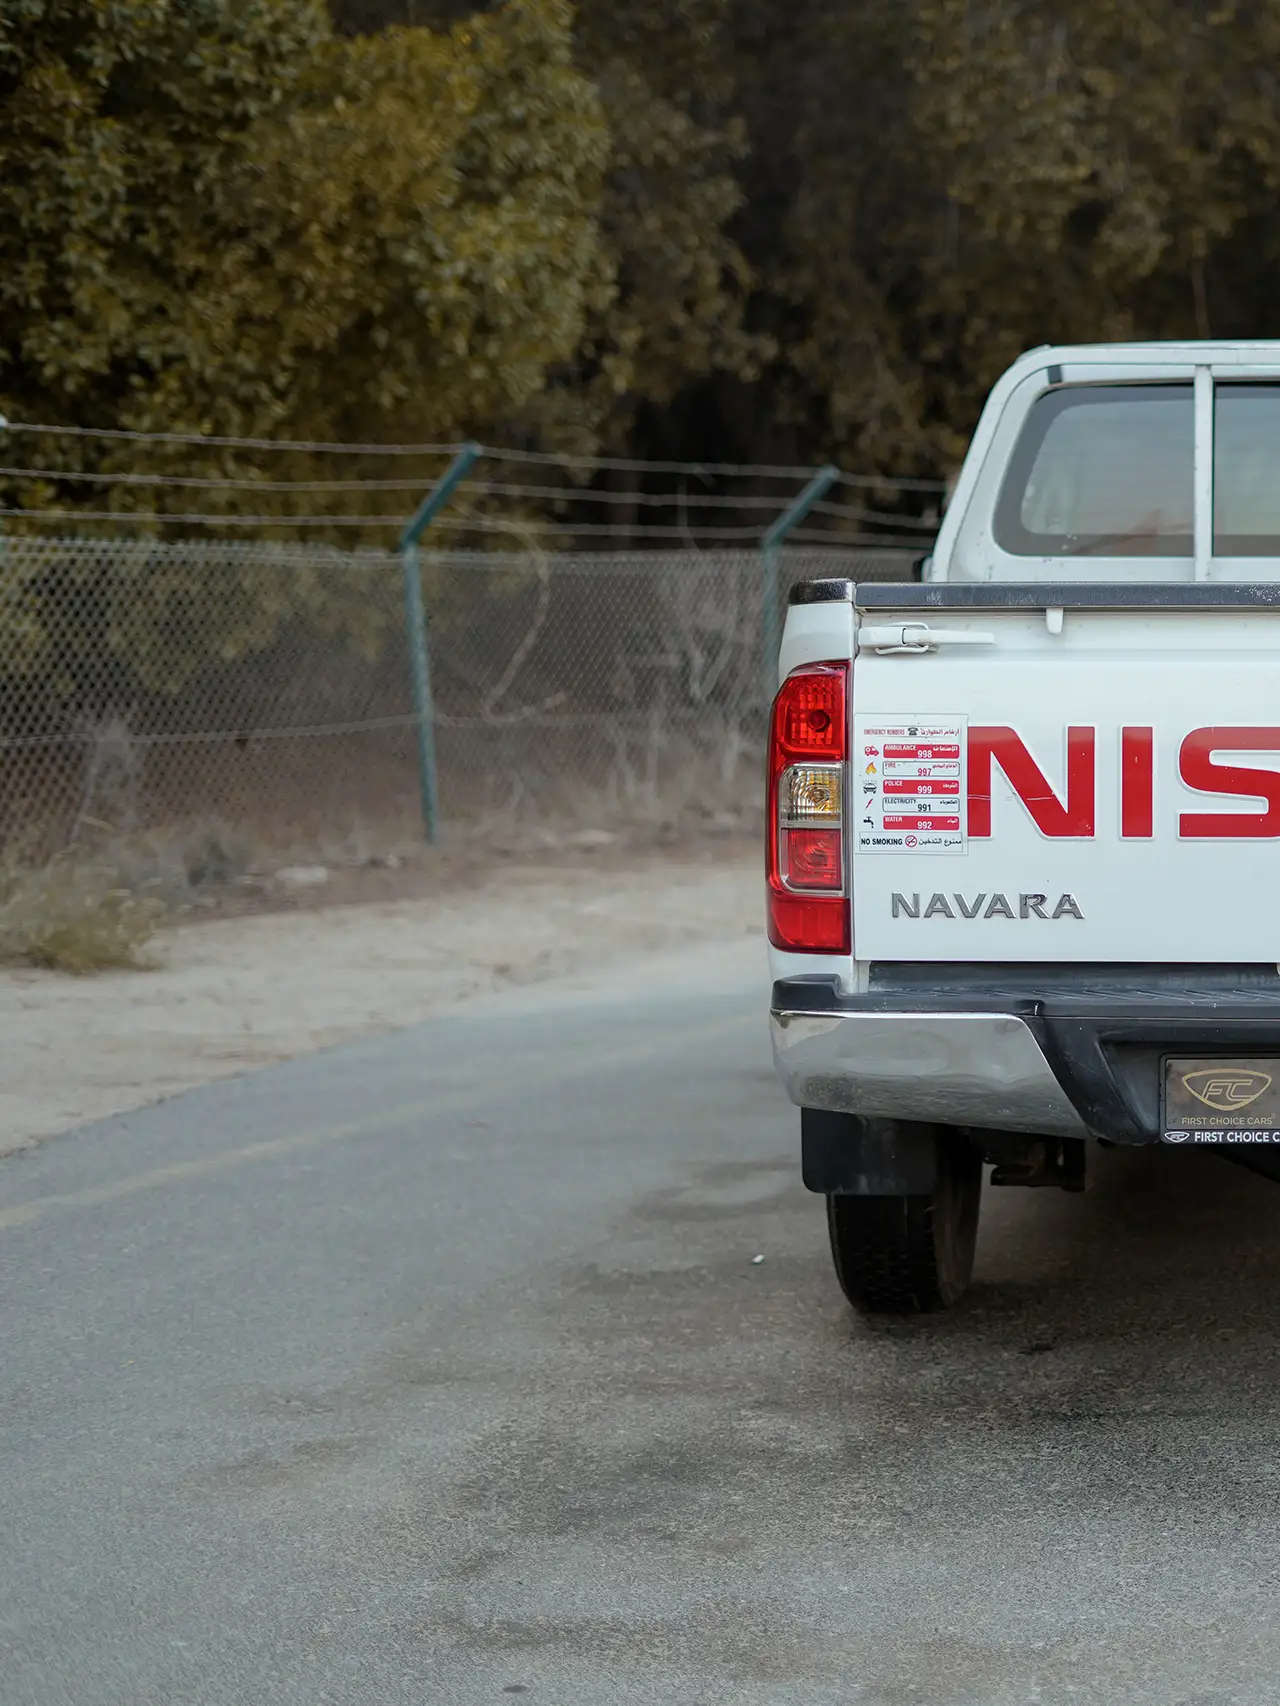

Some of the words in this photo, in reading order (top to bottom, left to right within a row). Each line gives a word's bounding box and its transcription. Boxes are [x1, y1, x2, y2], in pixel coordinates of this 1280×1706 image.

[917, 750, 932, 758] 998
[917, 768, 932, 776] 997
[917, 785, 932, 794] 999
[917, 804, 932, 812] 991
[917, 821, 932, 830] 992
[861, 838, 871, 846] NO
[872, 838, 903, 846] SMOKING
[892, 892, 1085, 919] NAVARA
[1181, 1117, 1207, 1125] FIRST
[1209, 1117, 1245, 1125] CHOICE
[1194, 1132, 1224, 1142] FIRST
[1226, 1132, 1270, 1142] CHOICE
